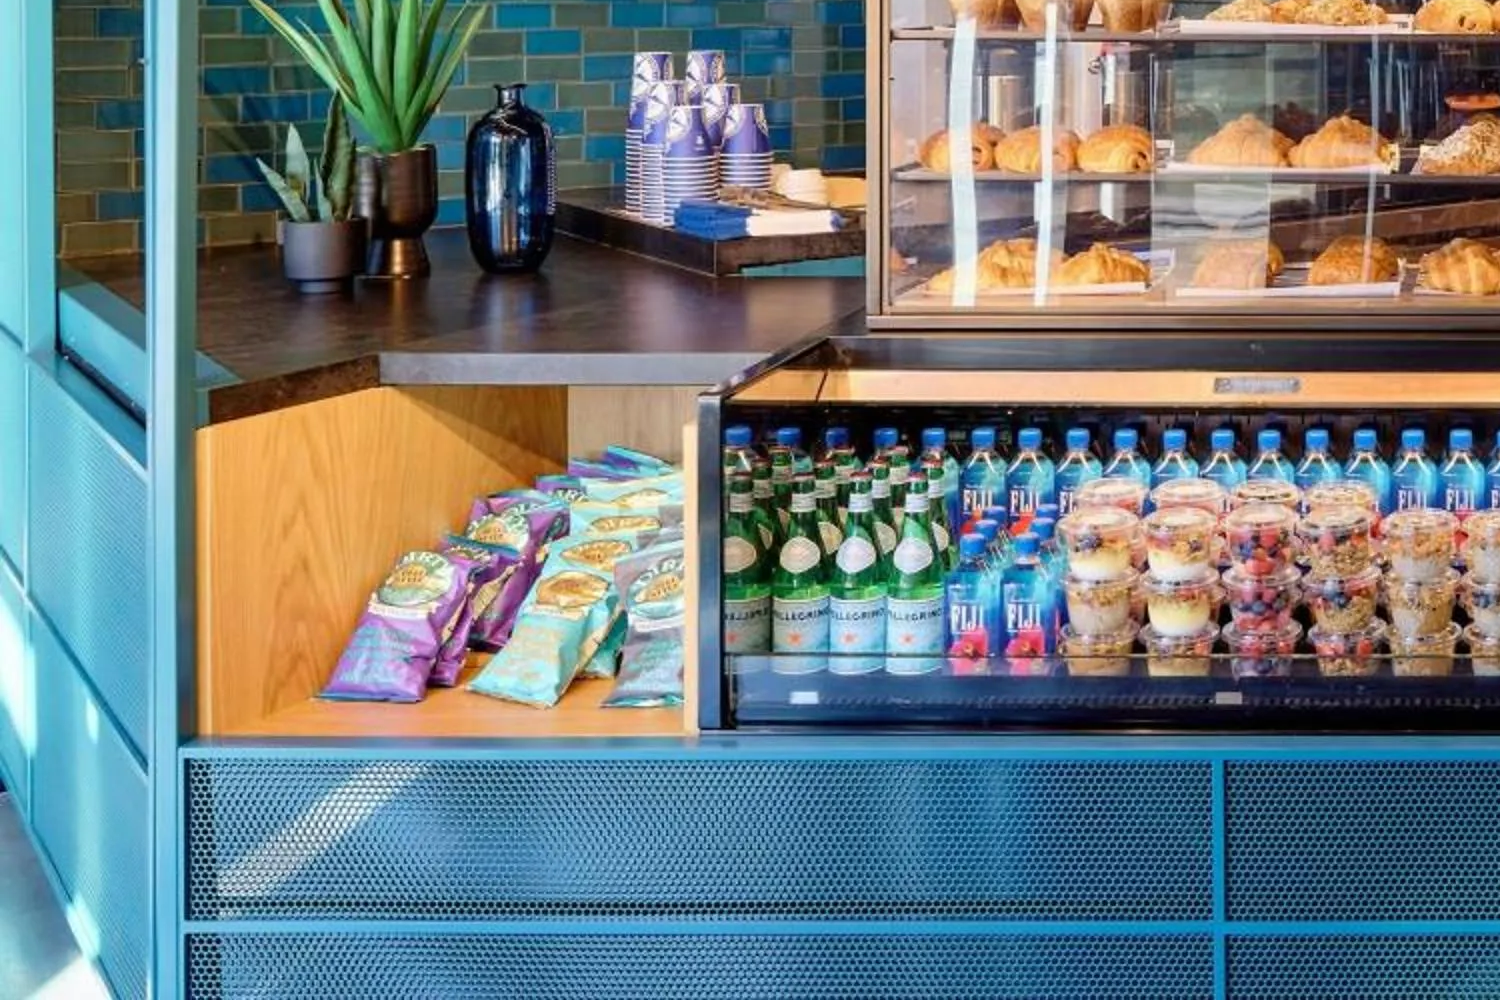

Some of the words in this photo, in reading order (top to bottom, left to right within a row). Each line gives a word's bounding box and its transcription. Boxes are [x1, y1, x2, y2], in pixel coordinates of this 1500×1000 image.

[963, 489, 993, 511] FIJI
[1011, 489, 1040, 513] FIJI
[951, 604, 984, 632] FIJI
[1008, 603, 1041, 631] FIJI
